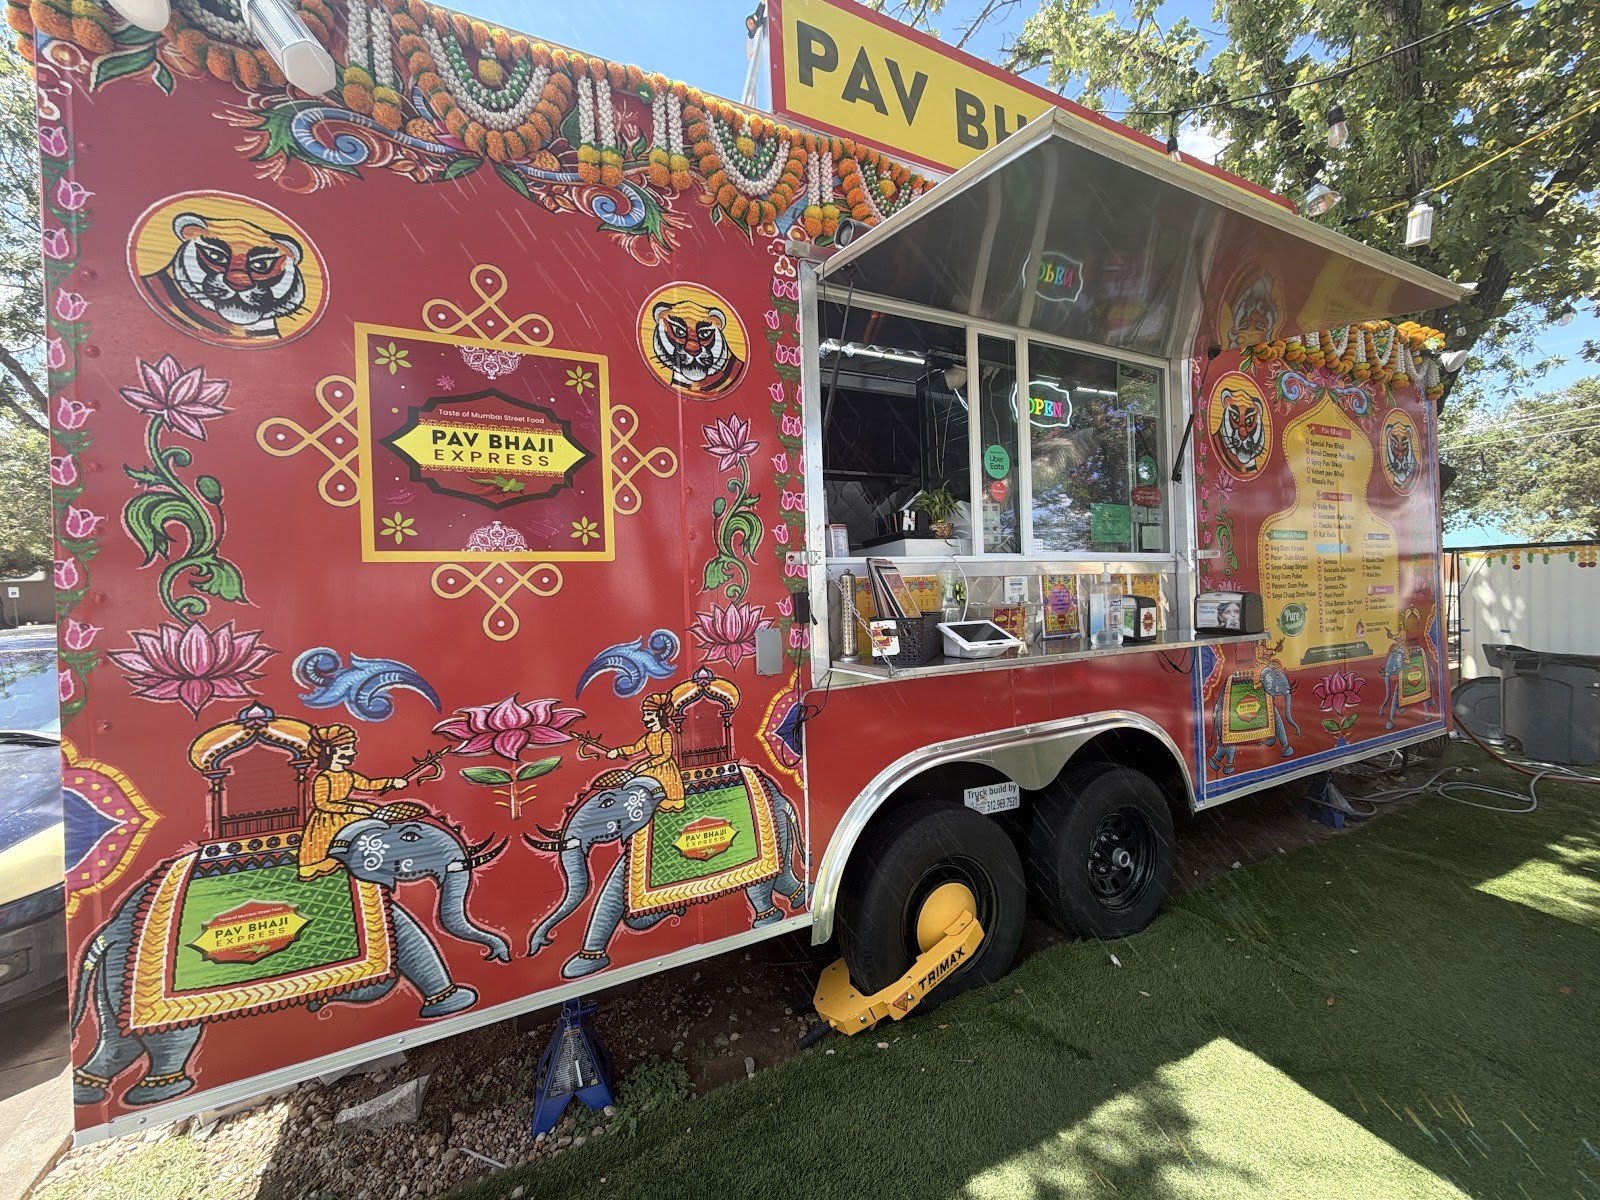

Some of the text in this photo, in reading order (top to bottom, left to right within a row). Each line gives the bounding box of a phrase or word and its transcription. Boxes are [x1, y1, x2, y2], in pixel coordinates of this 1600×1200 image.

[796, 20, 928, 127] PAV
[438, 408, 460, 418] Taste
[470, 413, 502, 421] Mumbai
[504, 414, 526, 423] Street
[527, 416, 545, 424] Food
[432, 429, 554, 453] PAV BHAJI
[1310, 440, 1325, 448] Special
[1334, 443, 1345, 451] Bhaji
[434, 449, 550, 467] EXPRESS
[1284, 608, 1300, 622] Pure
[966, 784, 1016, 799] Truck build by
[686, 828, 727, 842] PAV BHAJI
[686, 836, 726, 848] EXPRESS
[215, 916, 289, 939] PAV BHAJI
[216, 927, 286, 947] EXPRESS
[918, 946, 966, 992] TRIMAX
